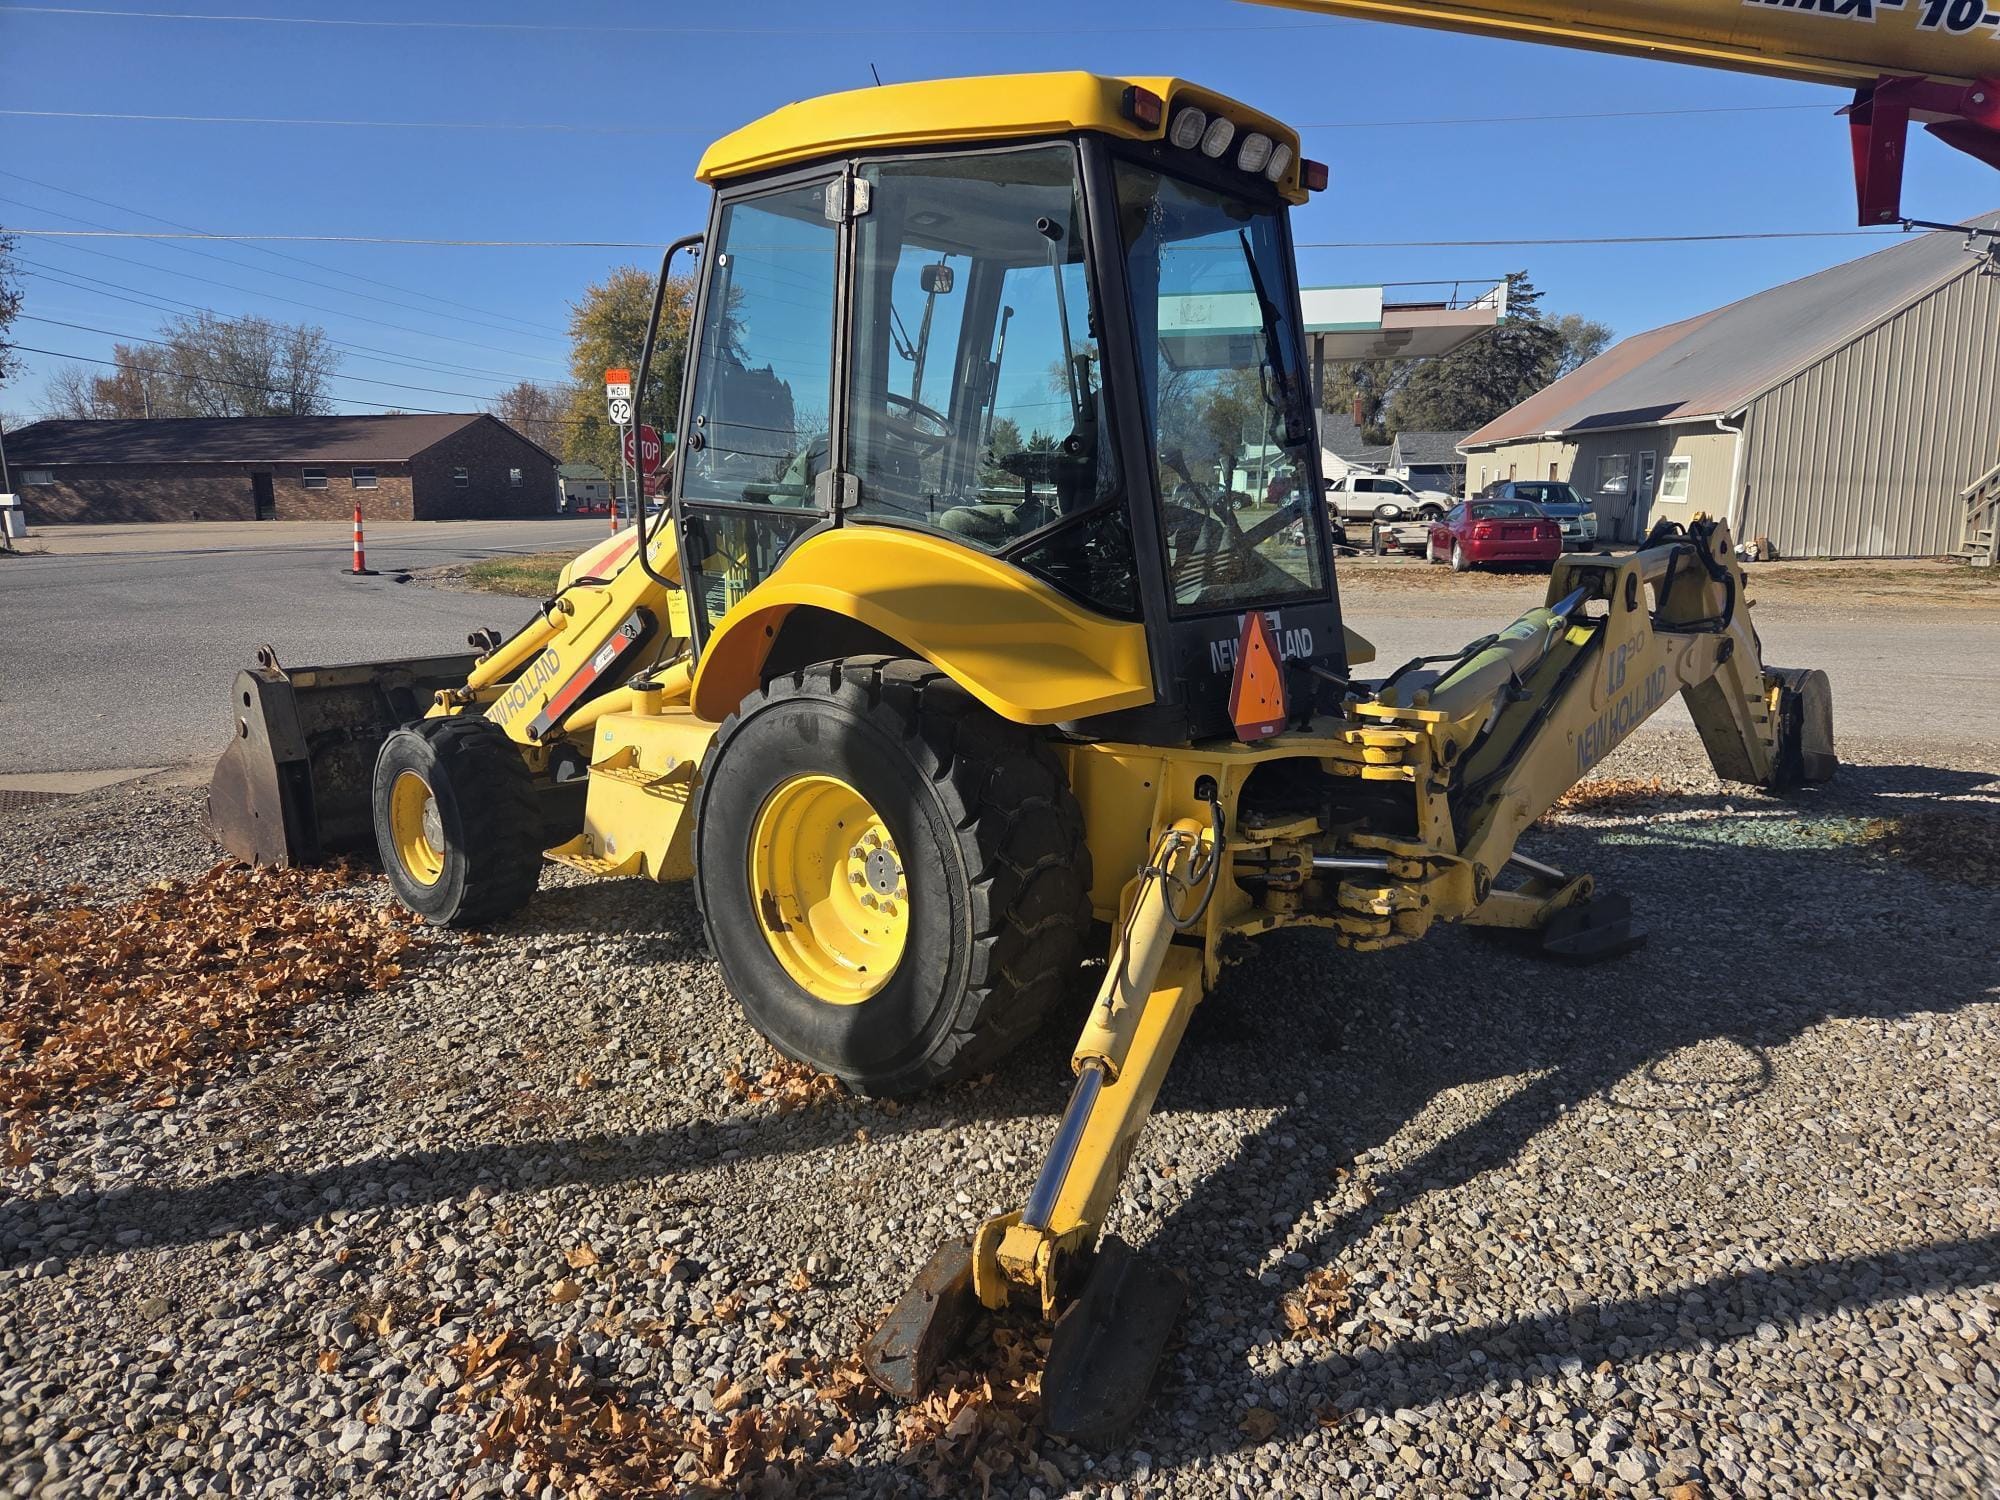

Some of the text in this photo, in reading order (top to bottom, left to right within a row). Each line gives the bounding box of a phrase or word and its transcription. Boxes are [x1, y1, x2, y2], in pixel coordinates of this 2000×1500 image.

[610, 386, 628, 397] WEST
[612, 403, 629, 420] 92
[503, 648, 561, 719] HOLLAND
[1576, 665, 1666, 775] NEW HOLLAND
